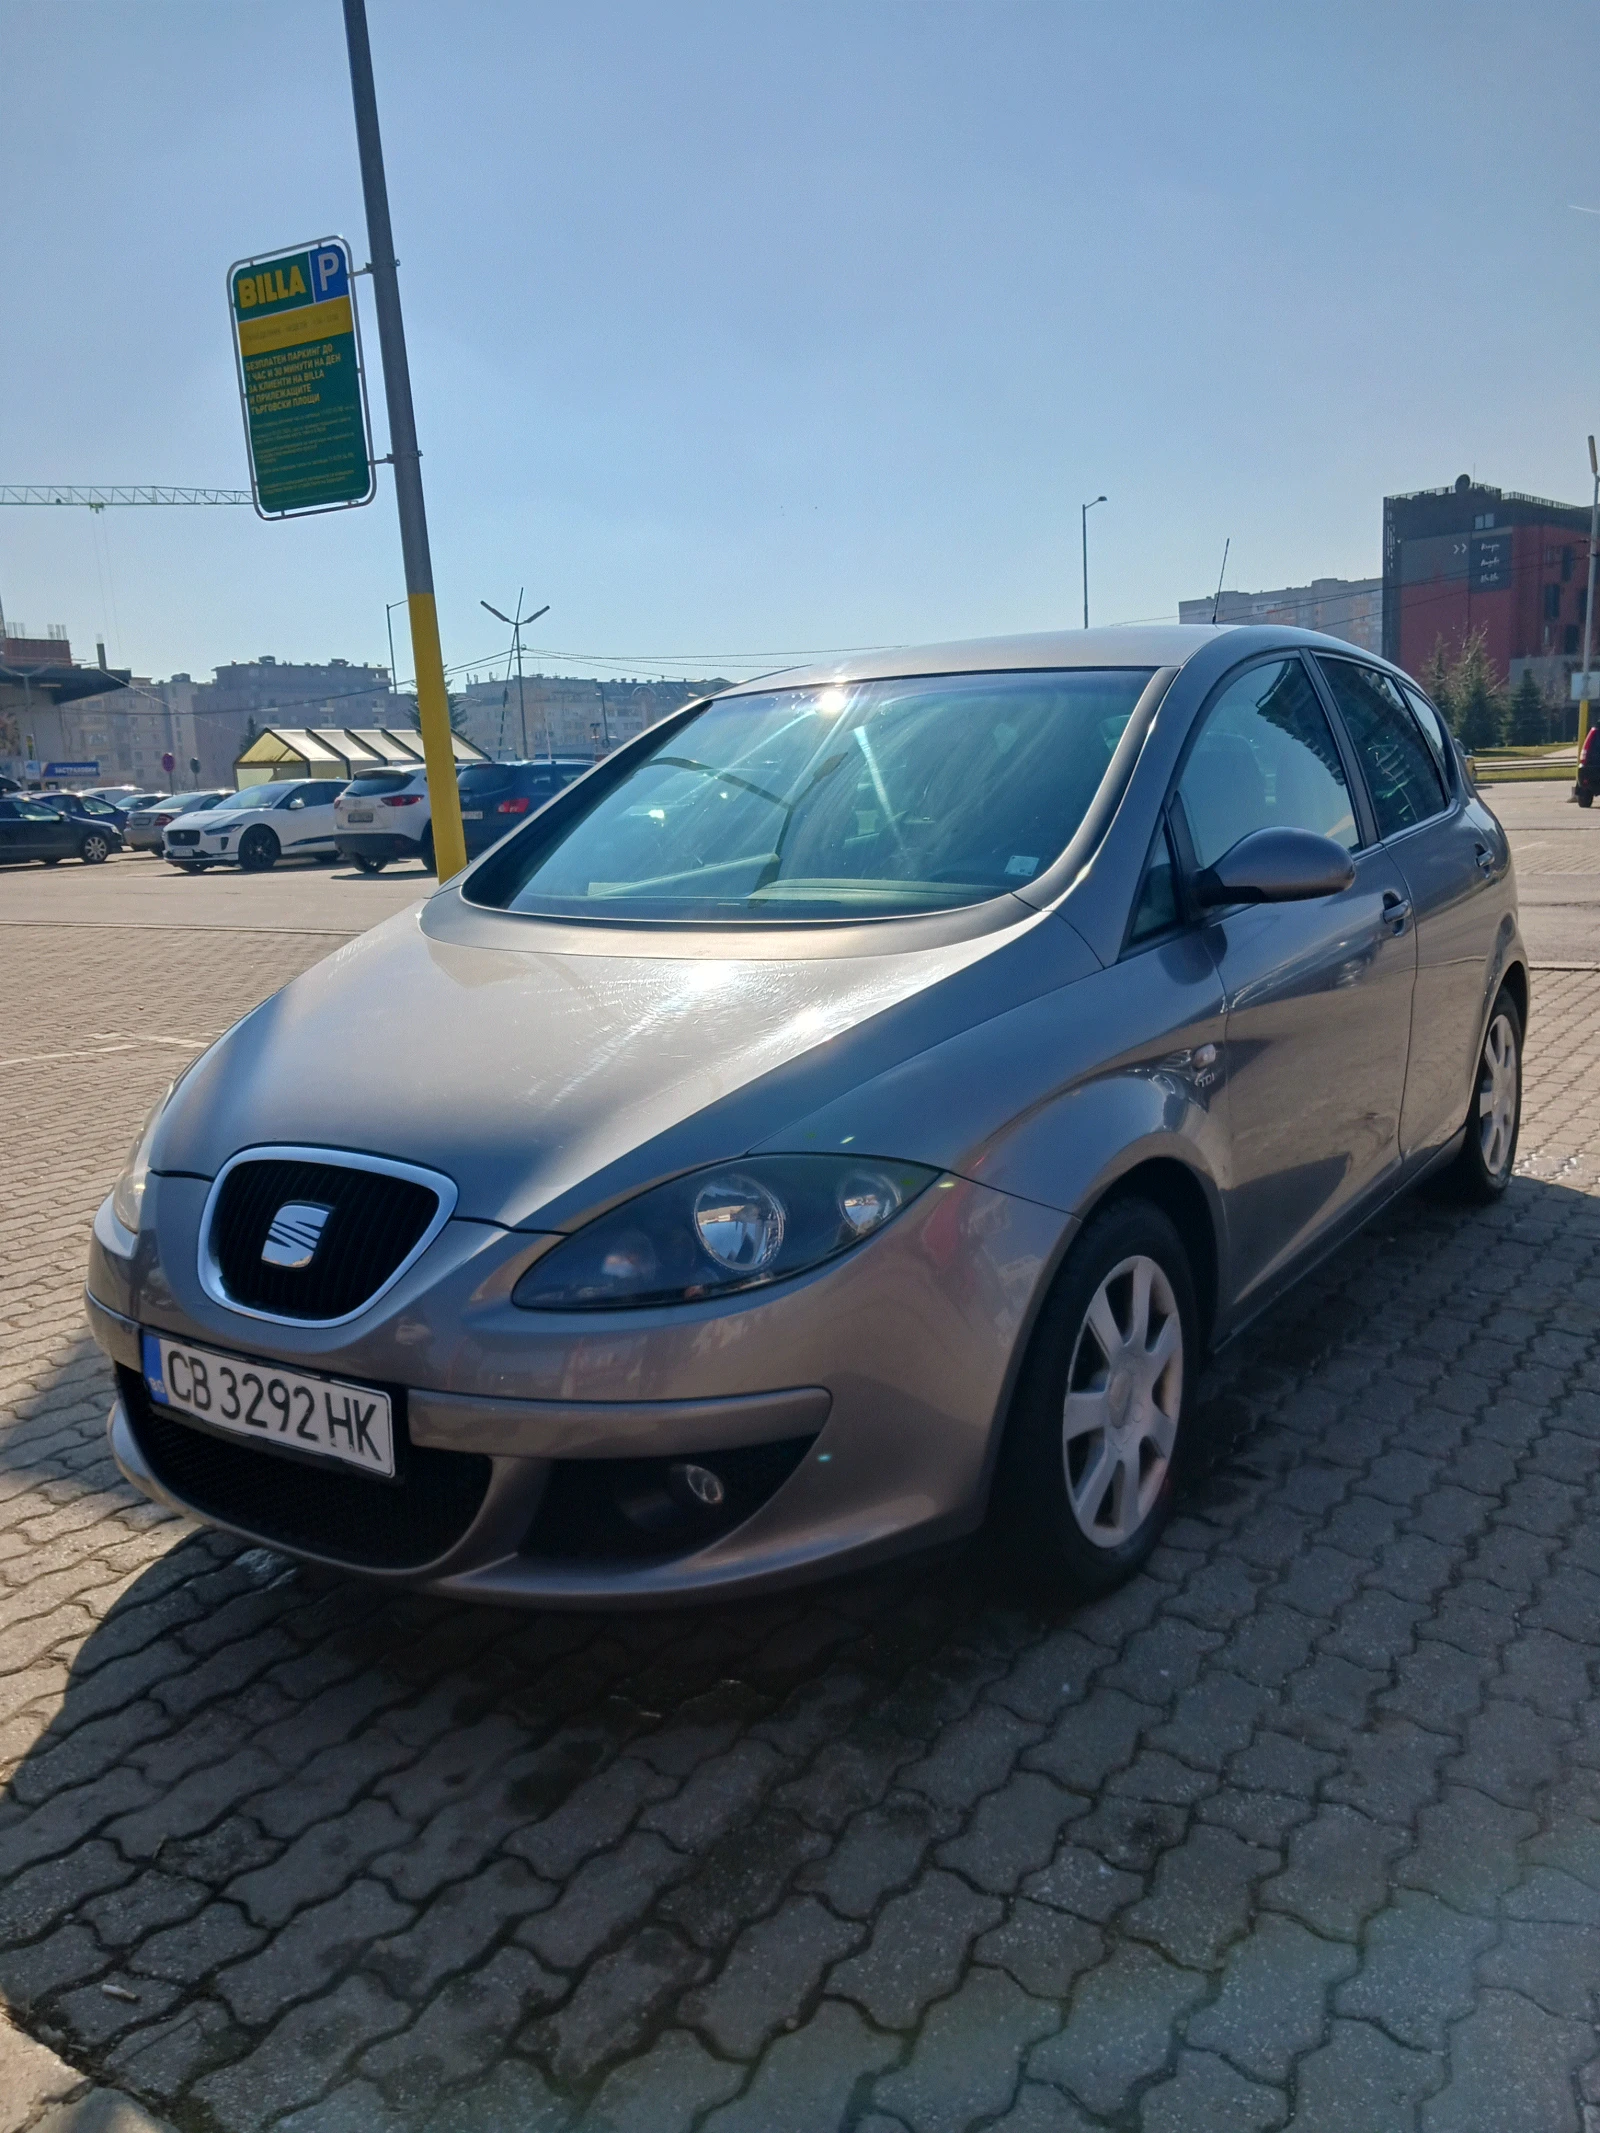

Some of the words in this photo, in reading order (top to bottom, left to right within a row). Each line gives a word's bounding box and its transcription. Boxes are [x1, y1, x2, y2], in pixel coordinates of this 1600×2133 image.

[318, 252, 339, 292] P
[238, 265, 307, 309] BILLA
[246, 356, 287, 371] БЕЗПЛАТЕН
[287, 346, 321, 362] ПАРКИНГ
[322, 343, 334, 355] ДО
[252, 369, 266, 381] ЧАС
[283, 359, 314, 374] МИНУТИ
[314, 357, 325, 367] НА
[325, 353, 342, 366] ДЕН
[248, 384, 258, 394] ЗА
[258, 377, 292, 392] КЛИЕНТИ
[292, 374, 303, 384] НА
[303, 369, 325, 382] BILLA
[256, 383, 312, 404] ПРИЛЕЖАЩИТЕ
[252, 401, 292, 415] ТЪРГОВСКИ
[292, 393, 321, 407] ПЛОЩИ
[219, 1366, 320, 1442] 3292
